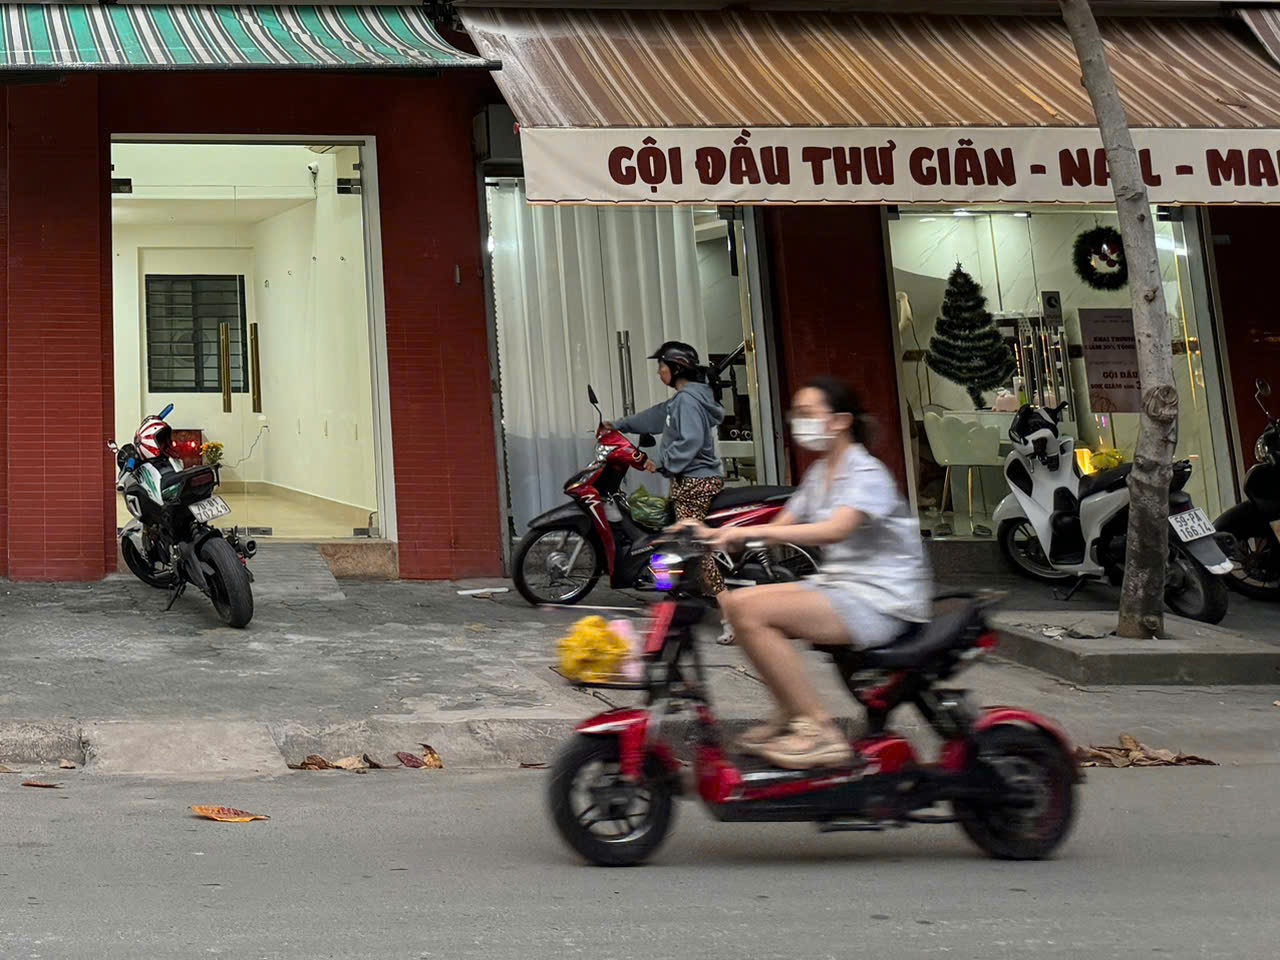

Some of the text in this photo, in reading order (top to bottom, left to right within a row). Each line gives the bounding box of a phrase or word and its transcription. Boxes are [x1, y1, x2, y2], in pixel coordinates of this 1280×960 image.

[608, 136, 683, 193] GỘI
[695, 129, 790, 186] ĐẦU
[802, 139, 897, 186] THƯ
[909, 138, 1017, 187] GIÃN
[1059, 147, 1161, 187] NAL
[1205, 148, 1280, 187] MA
[1179, 521, 1212, 539] 166.14
